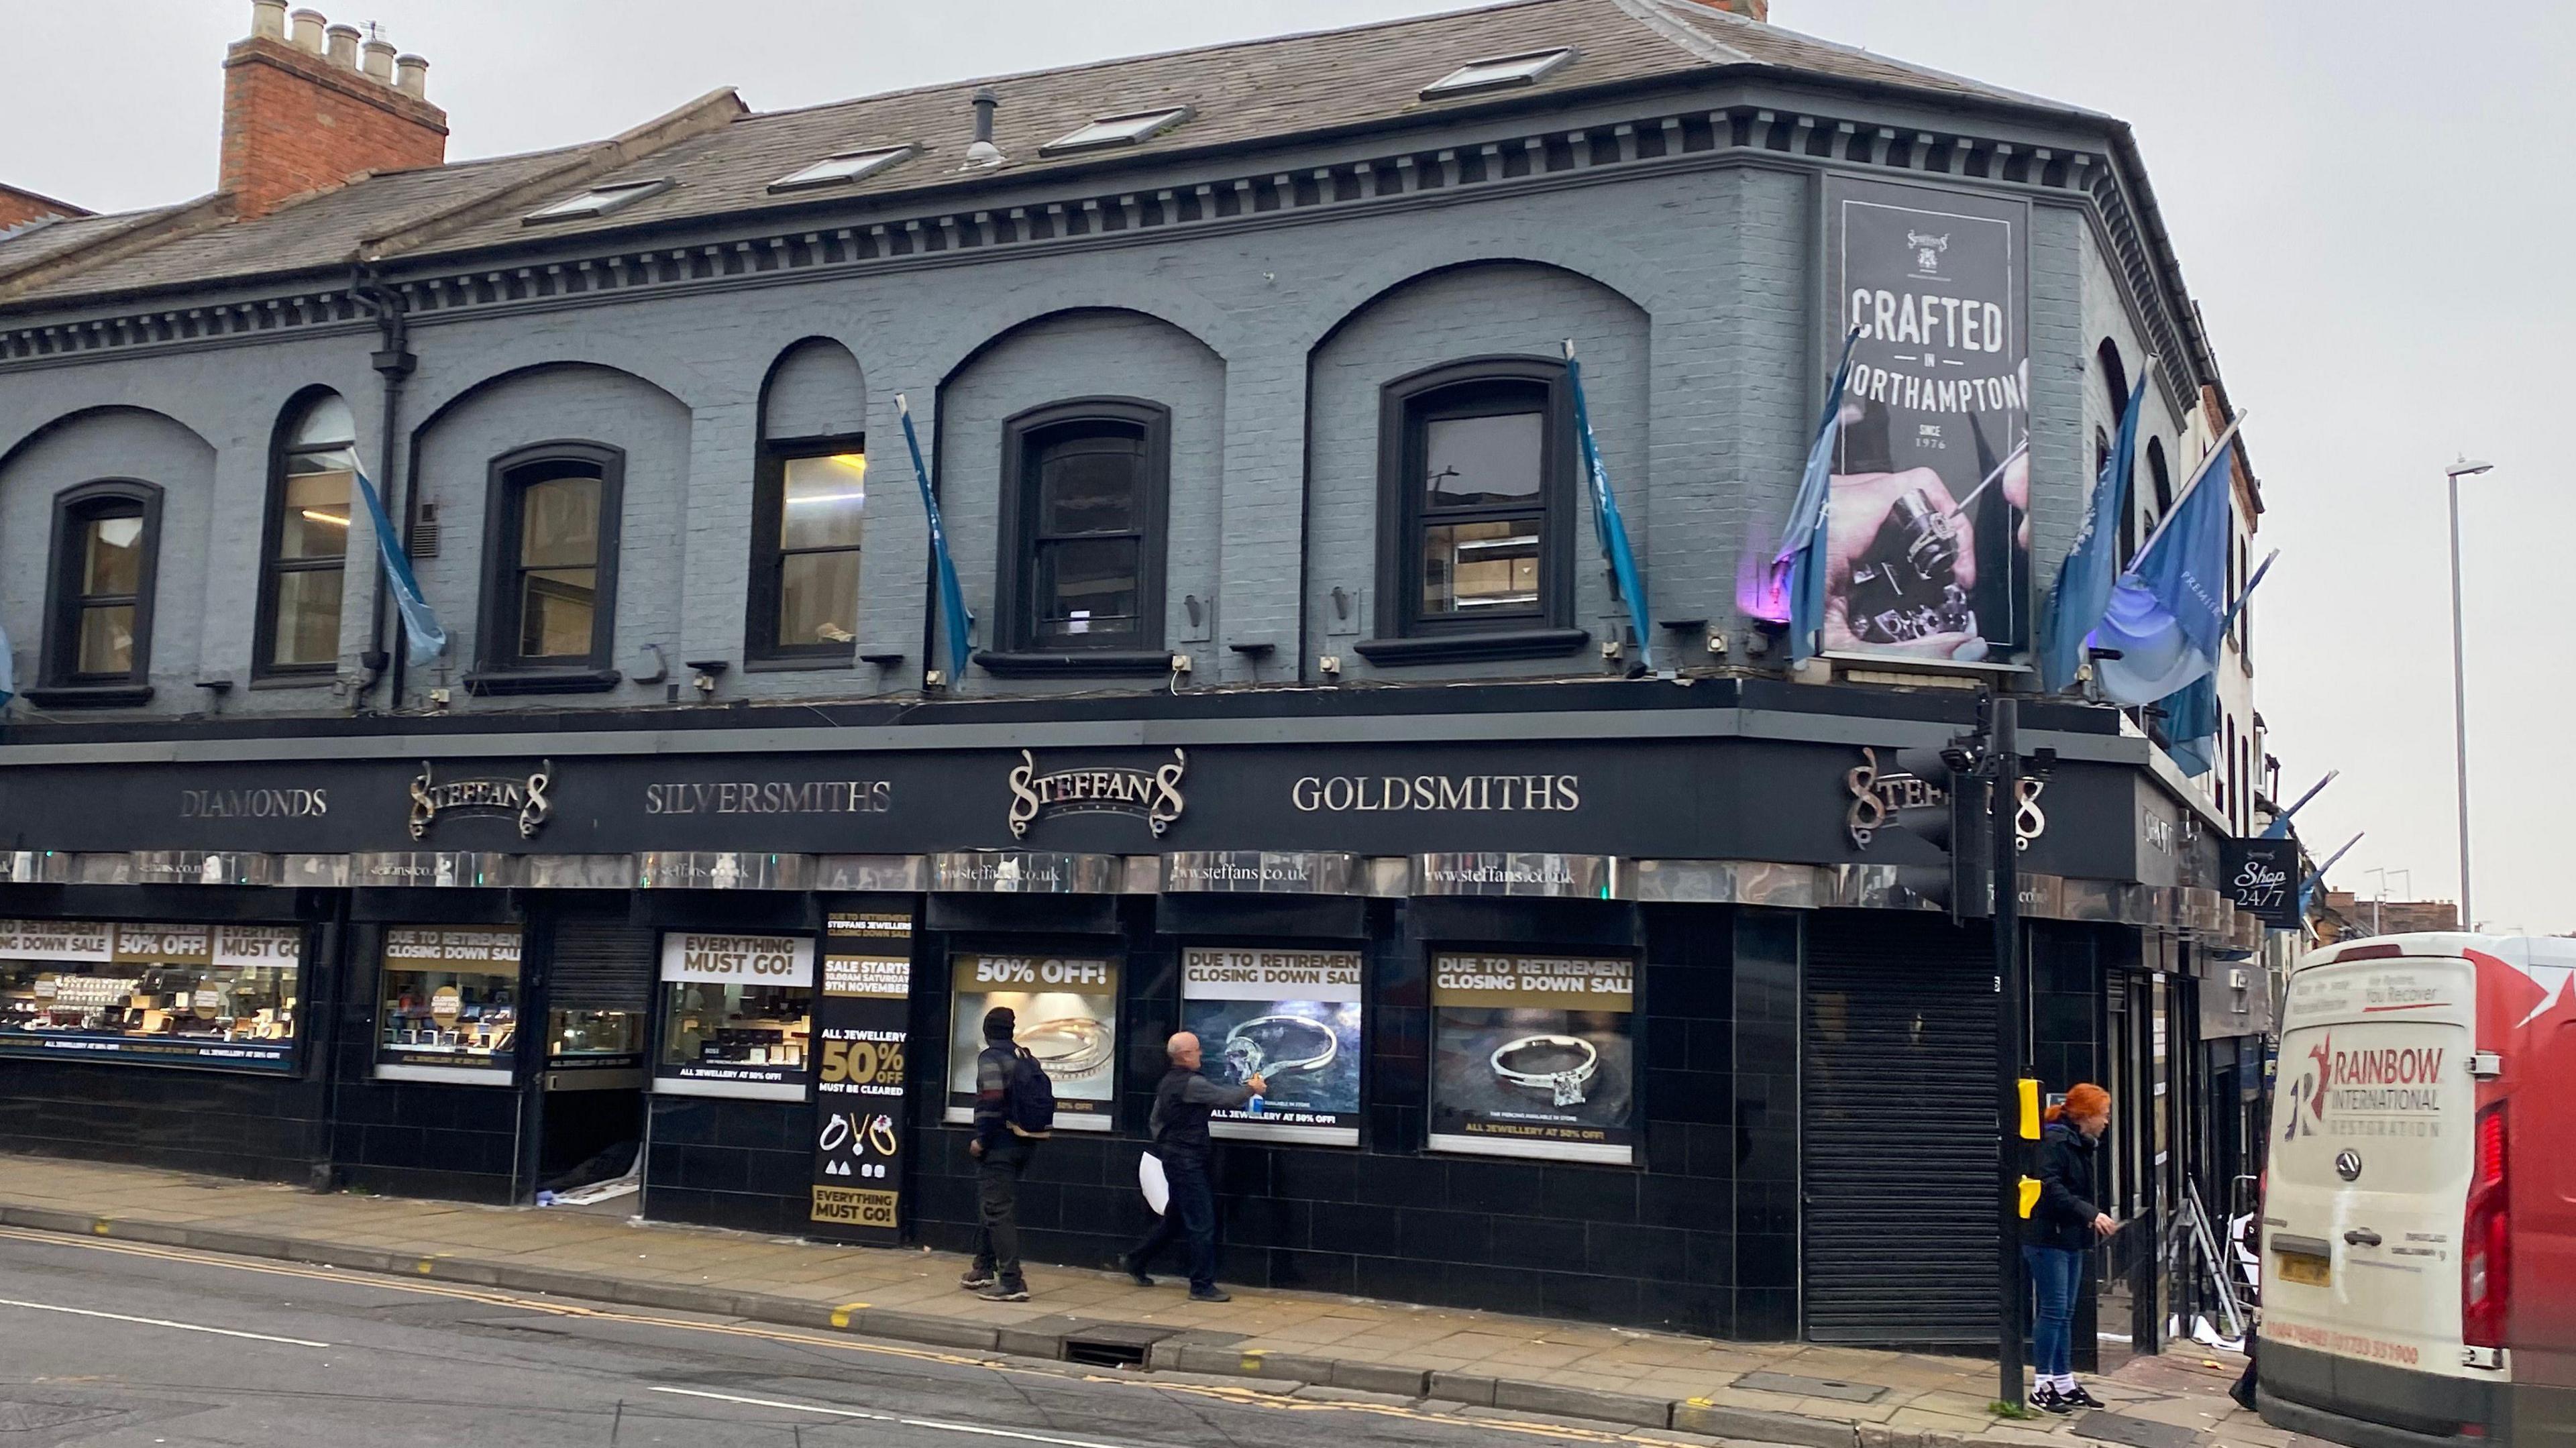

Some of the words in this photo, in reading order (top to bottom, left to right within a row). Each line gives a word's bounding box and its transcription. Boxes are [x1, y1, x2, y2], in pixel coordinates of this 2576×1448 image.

[1851, 288, 2002, 353] CRAFTED
[1924, 353, 1935, 368] IN
[1919, 424, 1941, 437] SINCE
[1915, 437, 1945, 449] 1976
[2180, 570, 2223, 617] PREMIER
[409, 758, 552, 842] STEFFANS
[645, 781, 892, 814] SILVERSMITHS
[1008, 747, 1185, 840] STEFFANS
[1291, 774, 1580, 812] GOLDSMITHS
[1847, 746, 2045, 852] STEFS
[179, 788, 327, 818] DIAMONDS
[2234, 861, 2286, 890] Shop
[2236, 888, 2286, 907] 24/7
[23, 936, 66, 951] DOWN
[71, 938, 104, 952] SALE
[118, 934, 159, 954] 50%
[162, 936, 207, 955] OFF!
[388, 930, 415, 944] DUE
[419, 931, 439, 944] TO
[684, 936, 794, 954] EVERYTHING
[221, 939, 272, 957] MUST
[387, 945, 440, 959] CLOSING
[445, 946, 488, 960] DOWN
[684, 952, 747, 973] MUST
[753, 954, 792, 975] GO!
[826, 960, 858, 973] SALE
[861, 961, 910, 975] STARTS
[1189, 952, 1224, 966] DUE
[1229, 953, 1254, 967] TO
[1438, 957, 1477, 973] DUE
[1483, 958, 1510, 974] TO
[862, 973, 909, 984] SATURDAY
[976, 958, 1035, 983] 50%
[1041, 959, 1106, 985] OFF!
[1187, 968, 1258, 983] CLOSING
[1265, 970, 1320, 984] DOWN
[1326, 970, 1361, 985] SAL
[825, 981, 847, 991] 9TH
[847, 982, 909, 994] NOVEMBER
[1437, 974, 1515, 991] CLOSING
[1521, 976, 1585, 992] DOWN
[2387, 986, 2438, 1003] Recover
[822, 1028, 841, 1040] ALL
[843, 1029, 907, 1042] JEWELLERY
[820, 1041, 904, 1084] 50%
[2334, 1048, 2444, 1085] RAINBOW
[876, 1070, 904, 1084] OFF
[819, 1082, 845, 1093] MUST
[847, 1084, 859, 1093] BE
[860, 1085, 904, 1096] CLEARED
[2331, 1089, 2440, 1111] INTERNATIONAL
[1211, 1109, 1228, 1117] ALL
[1283, 1113, 1295, 1121] AT
[1466, 1122, 1484, 1132] ALL
[1486, 1123, 1543, 1135] JEWELLERY
[1546, 1127, 1558, 1136] AT
[816, 1190, 892, 1206] EVERYTHING
[815, 1202, 859, 1219] MUST
[863, 1207, 891, 1222] GO!
